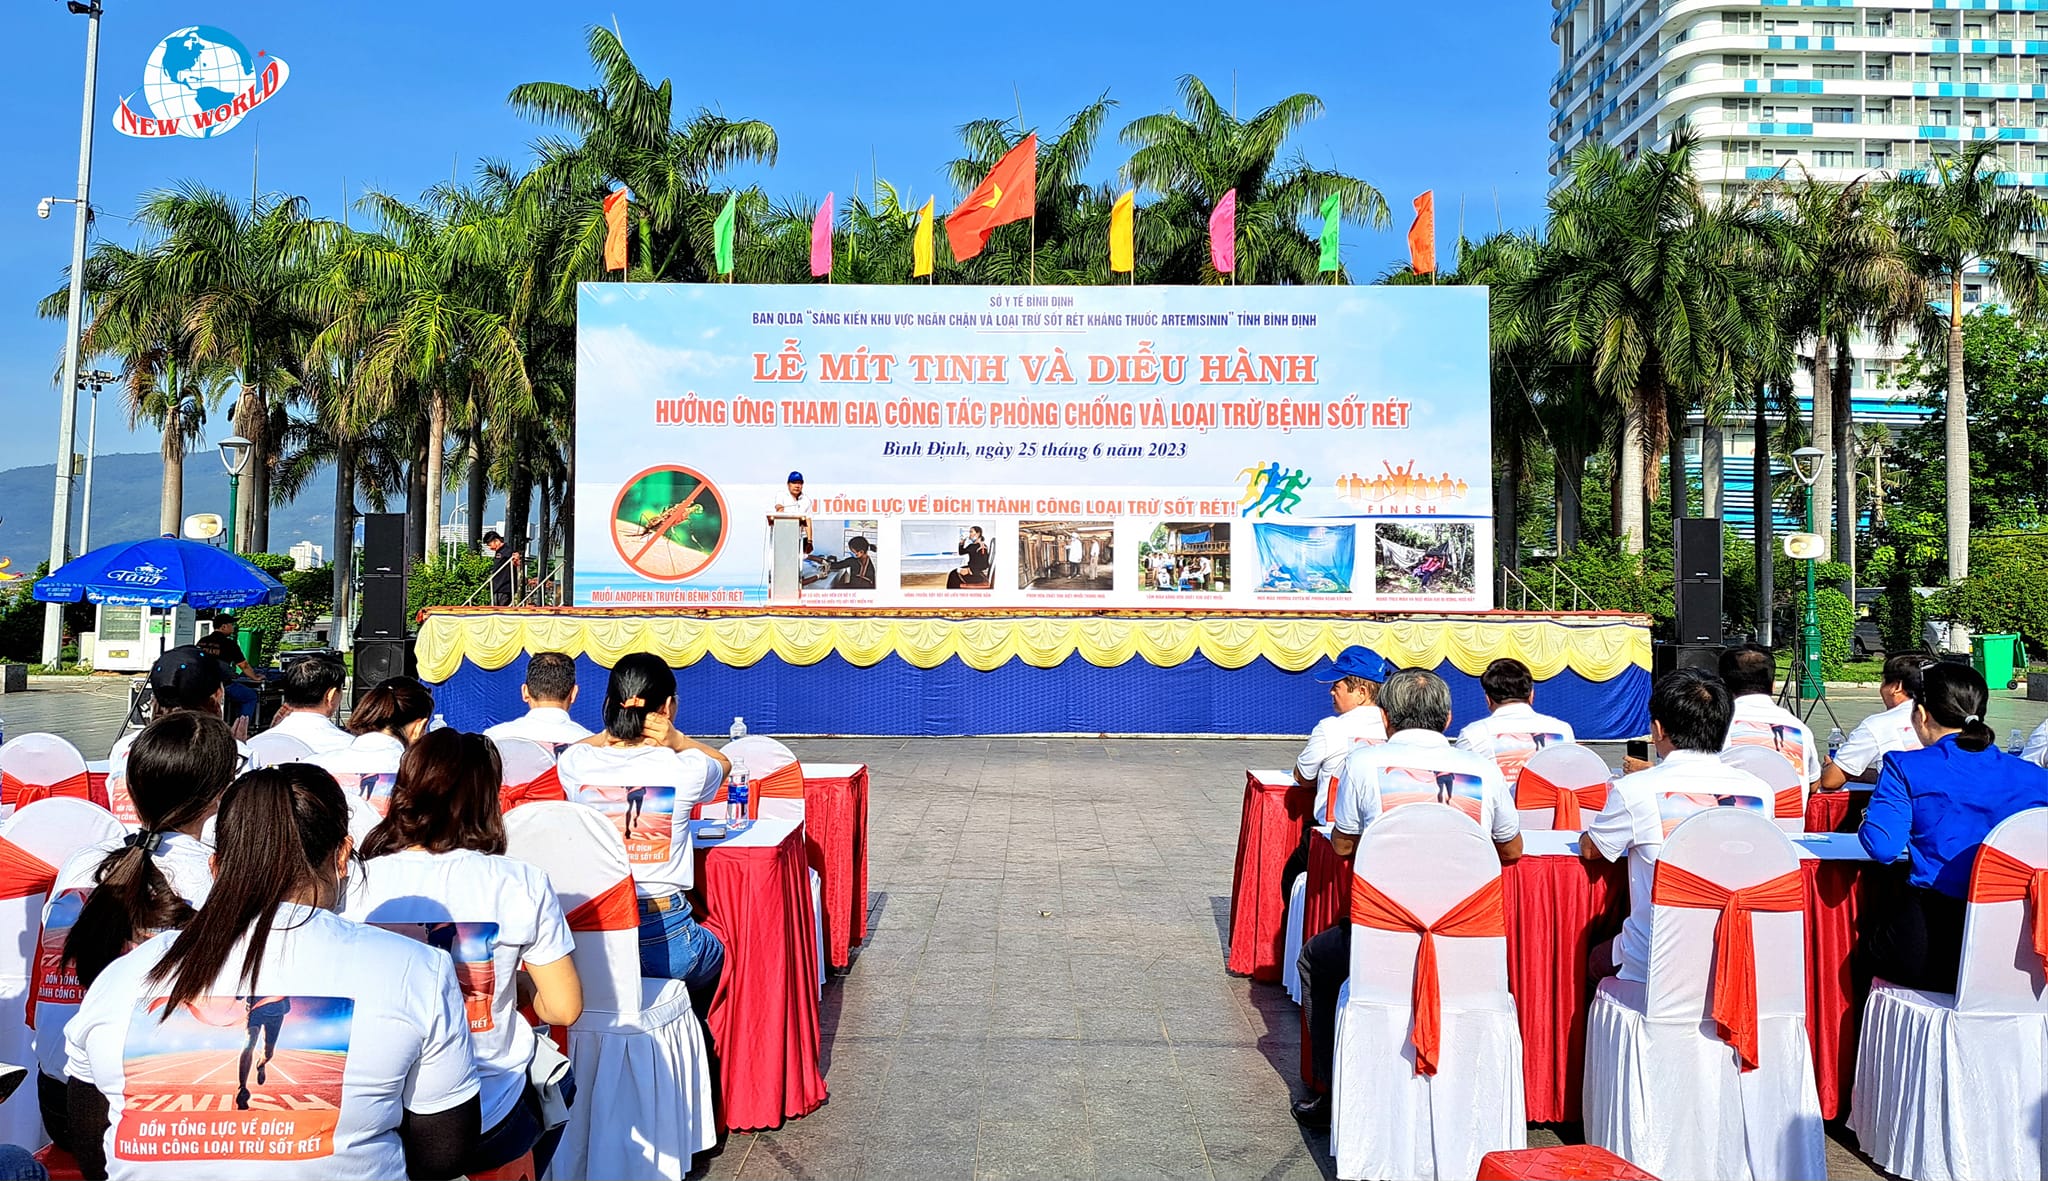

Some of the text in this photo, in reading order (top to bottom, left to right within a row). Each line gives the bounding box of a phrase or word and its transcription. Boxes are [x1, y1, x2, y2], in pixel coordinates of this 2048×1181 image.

[1005, 296, 1011, 307] Y
[1013, 293, 1024, 307] TẾ
[1026, 294, 1049, 307] BÌNH
[753, 312, 774, 325] BAN
[777, 312, 803, 325] QLDA
[844, 309, 868, 325] KIẾN
[871, 313, 891, 326] KHU
[894, 313, 914, 328] VỰC
[917, 311, 946, 326] NGĂN
[949, 312, 977, 328] CHẶN
[980, 312, 993, 326] VÀ
[996, 314, 1019, 328] LOẠI
[1022, 312, 1042, 326] TRỪ
[1044, 311, 1063, 326] SỐT
[1066, 312, 1084, 326] RÉT
[1088, 312, 1122, 326] KHÁNG
[1125, 311, 1158, 326] THUỐC
[1237, 311, 1260, 326] TỈNH
[1264, 312, 1289, 326] BÌNH
[1292, 314, 1317, 328] ĐỊNH
[753, 339, 1316, 383] LỄ MÍT TINH VÀ DIỄU HÀNH
[656, 392, 1408, 431] HƯỞNG ỨNG THAM GIA CÔNG TÁC PHÒNG CHỐNG VÀ LOẠI TRỪ BỆNH SỐT RÉT
[883, 441, 1187, 460] Bình Định, ngày 25 tháng 6 năm 2023
[824, 493, 866, 513] TỔNG
[872, 497, 903, 518] LỰC
[933, 496, 971, 513] ĐÍCH
[977, 496, 1031, 513] THÀNH
[1036, 497, 1080, 514] CÔNG
[1087, 500, 1122, 518] LOẠI
[1127, 497, 1161, 515] TRỪ
[1164, 495, 1195, 515] SỐT
[1200, 498, 1236, 515] RÉT!
[1368, 505, 1437, 514] FINISH
[615, 591, 652, 602] ANOPHEN
[55, 986, 75, 999] CÔNG
[471, 1015, 488, 1029] RÉT
[171, 1117, 207, 1136] TỔNG
[211, 1120, 237, 1138] LỰC
[260, 1118, 295, 1136] ĐÍCH
[119, 1135, 321, 1156] THÀNH CÔNG LOẠI TRỪ SỐT RÉT
